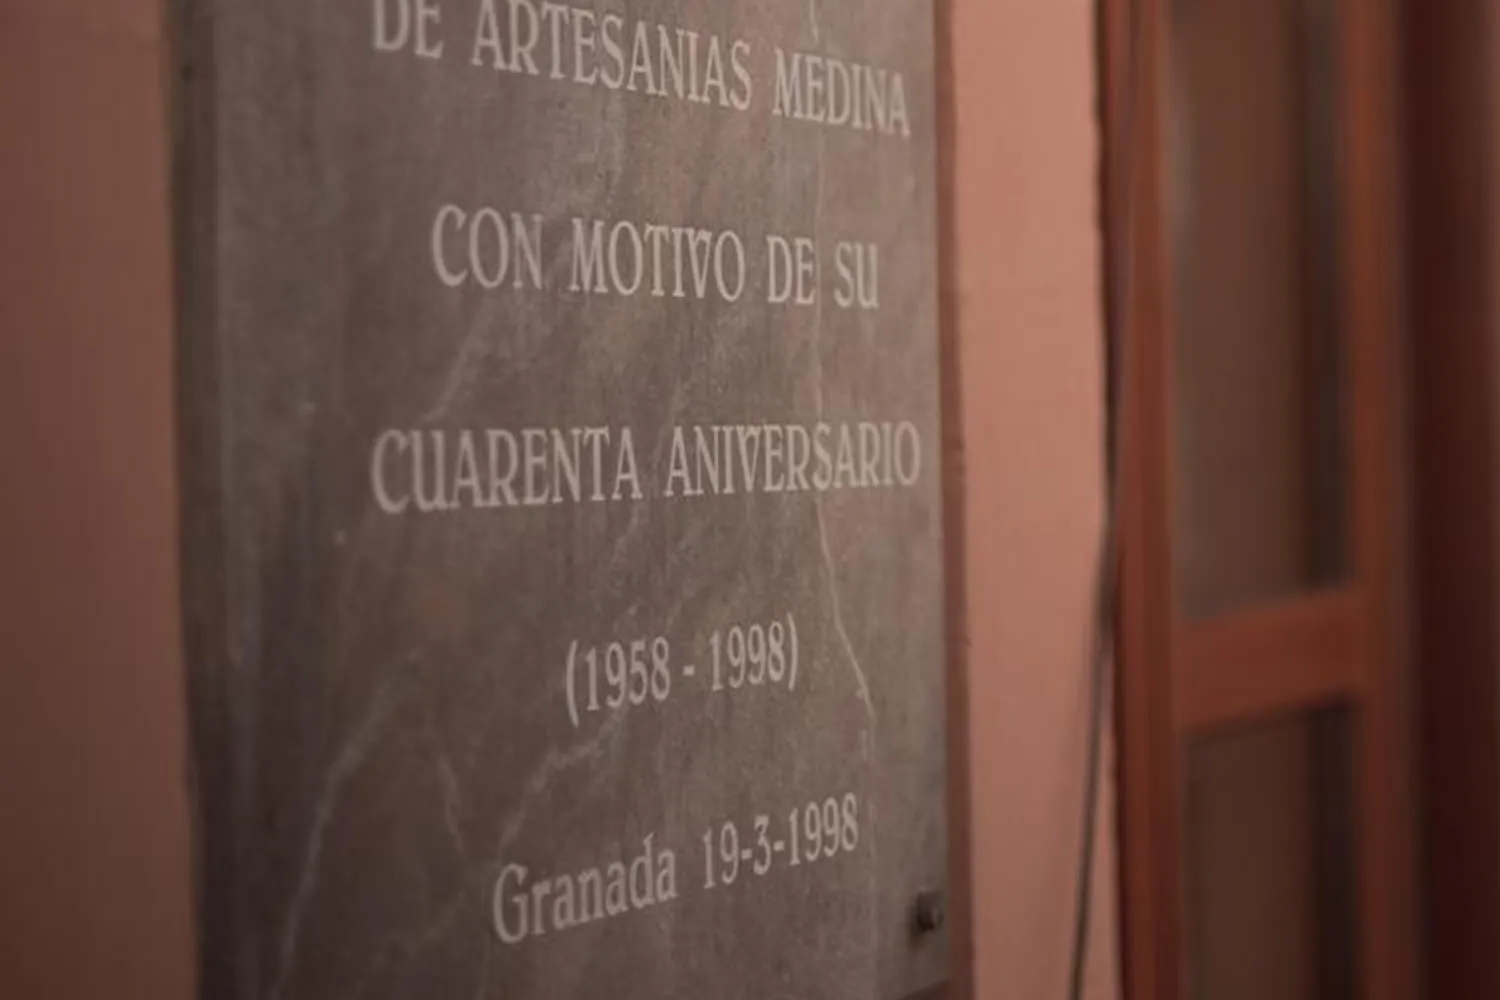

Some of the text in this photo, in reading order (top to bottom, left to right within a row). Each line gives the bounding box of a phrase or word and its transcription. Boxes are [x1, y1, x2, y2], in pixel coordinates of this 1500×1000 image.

[772, 47, 911, 138] MEDINA
[431, 204, 880, 310] CON MOTIVO DE SU
[370, 420, 922, 514] CUARENTA ANIVERSARIO
[491, 792, 859, 944] Granada 19-3-1998
